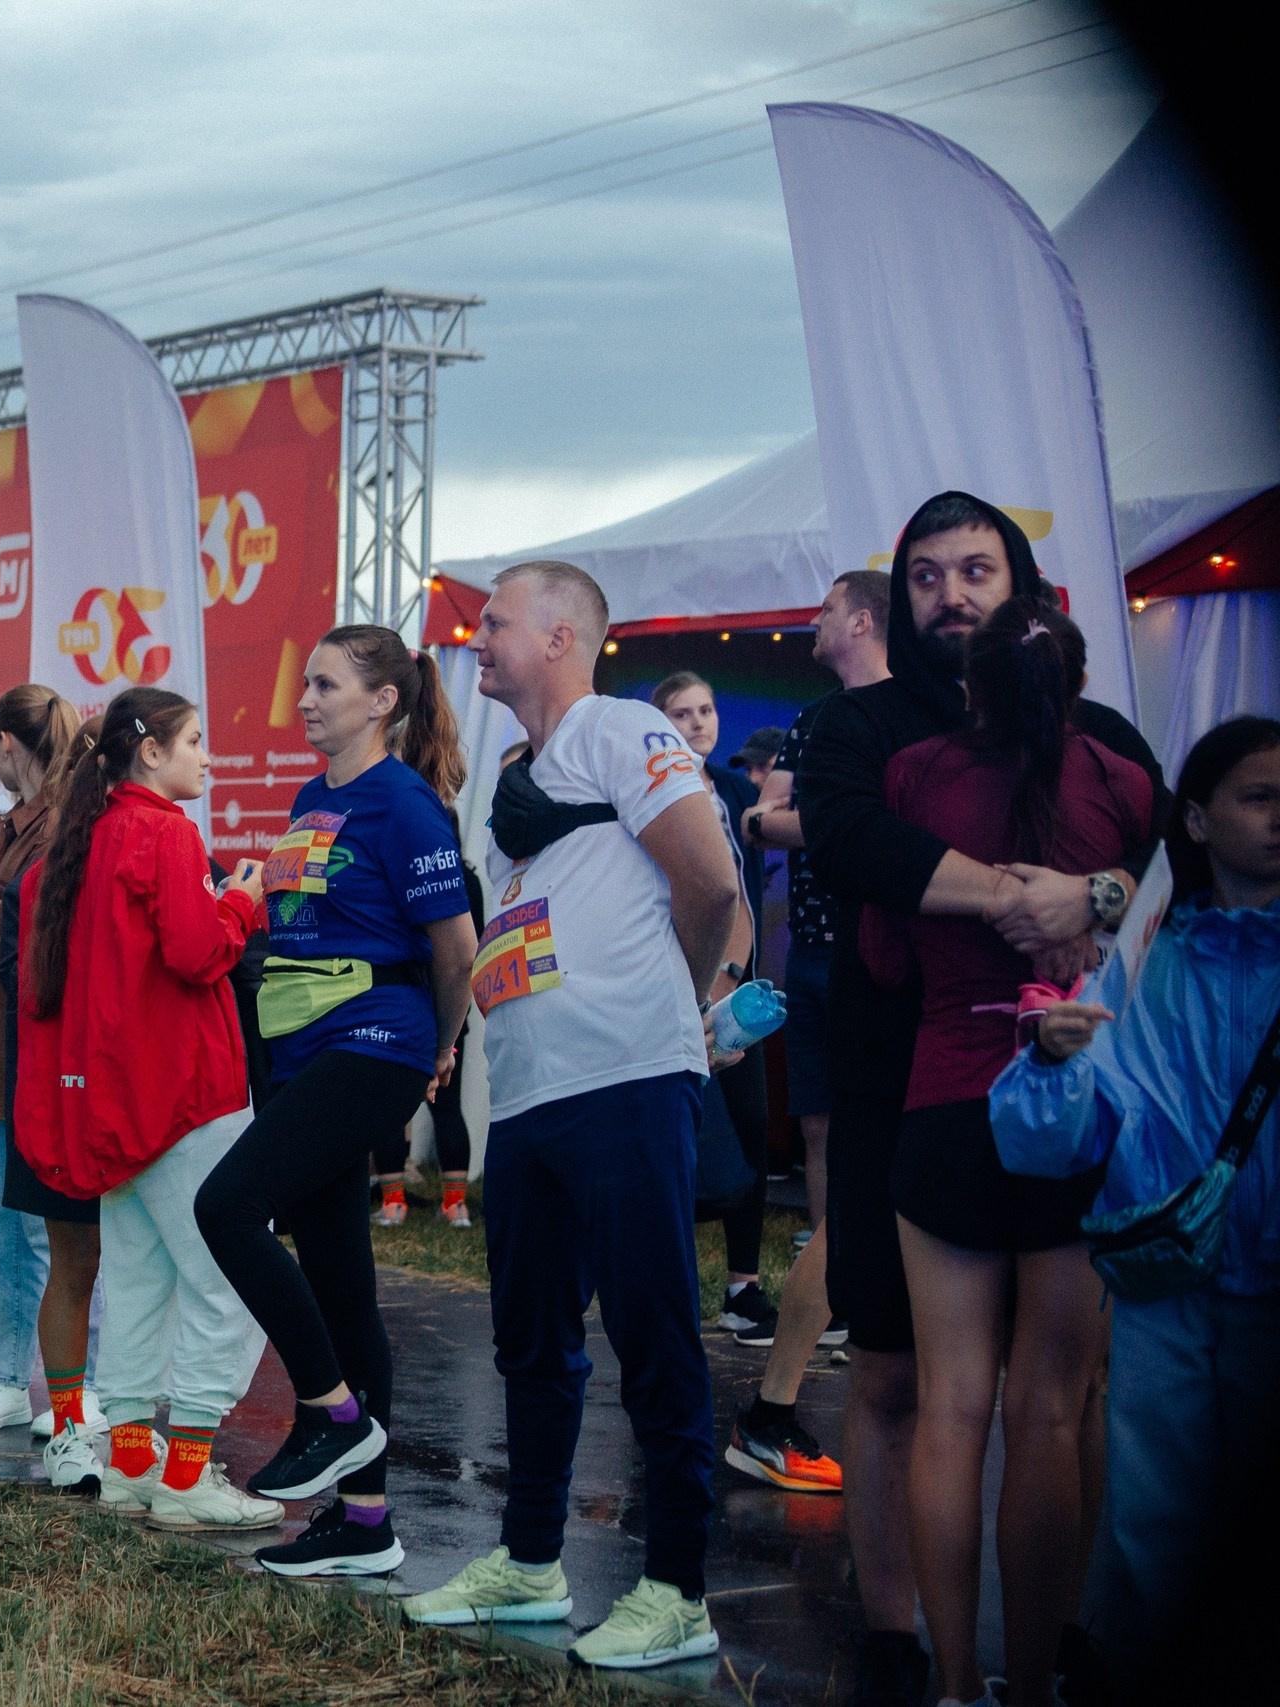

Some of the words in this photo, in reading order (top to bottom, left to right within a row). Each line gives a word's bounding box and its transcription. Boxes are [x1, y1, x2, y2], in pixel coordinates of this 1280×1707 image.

[211, 830, 252, 850] ижний
[406, 877, 461, 902] рейтинг
[111, 1426, 153, 1438] НОЧНО
[174, 1440, 211, 1455] НОЧН
